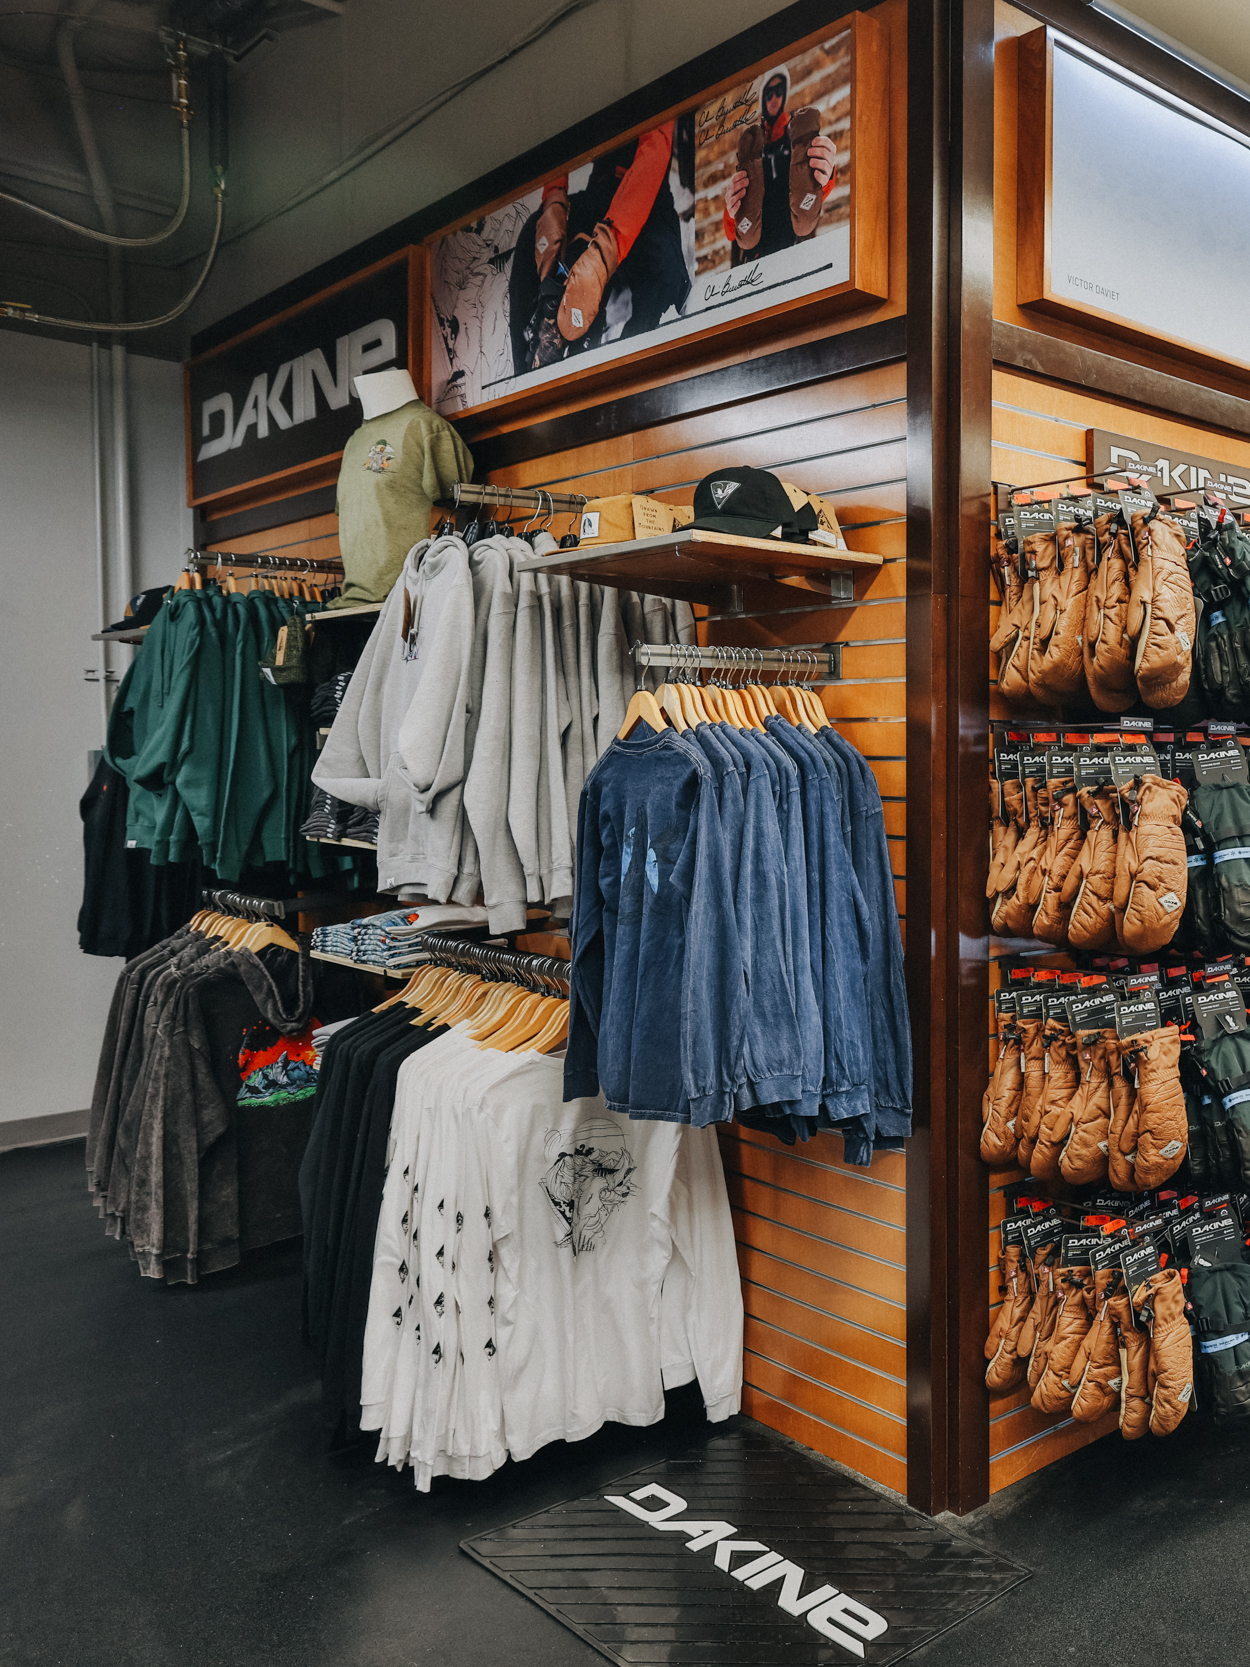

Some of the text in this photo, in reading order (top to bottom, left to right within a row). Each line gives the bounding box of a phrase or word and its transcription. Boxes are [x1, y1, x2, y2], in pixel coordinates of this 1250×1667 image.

[1067, 274, 1120, 301] VICTOR DAVIET
[197, 318, 396, 462] DAKINE
[1128, 462, 1157, 474] DAKINE
[1207, 480, 1232, 492] DAKINE
[640, 504, 658, 513] DRAWN
[637, 522, 665, 532] MOUNTAINS
[1123, 720, 1152, 728] DAKINE
[1198, 749, 1241, 761] DAKINE
[1207, 964, 1232, 973] DAKINE
[1129, 975, 1158, 985] DAKINE
[1159, 986, 1191, 999] DAKINE
[1198, 990, 1239, 1003] DAKINE
[1072, 994, 1116, 1011] DAKINE
[1120, 1002, 1155, 1014] DAKINE
[1204, 1194, 1230, 1207] DAKINE
[1134, 1218, 1162, 1234] DAKINE
[1192, 1218, 1234, 1235] DAKINE
[1125, 1246, 1155, 1264] DAKINE
[604, 1482, 888, 1658] DAKINE
